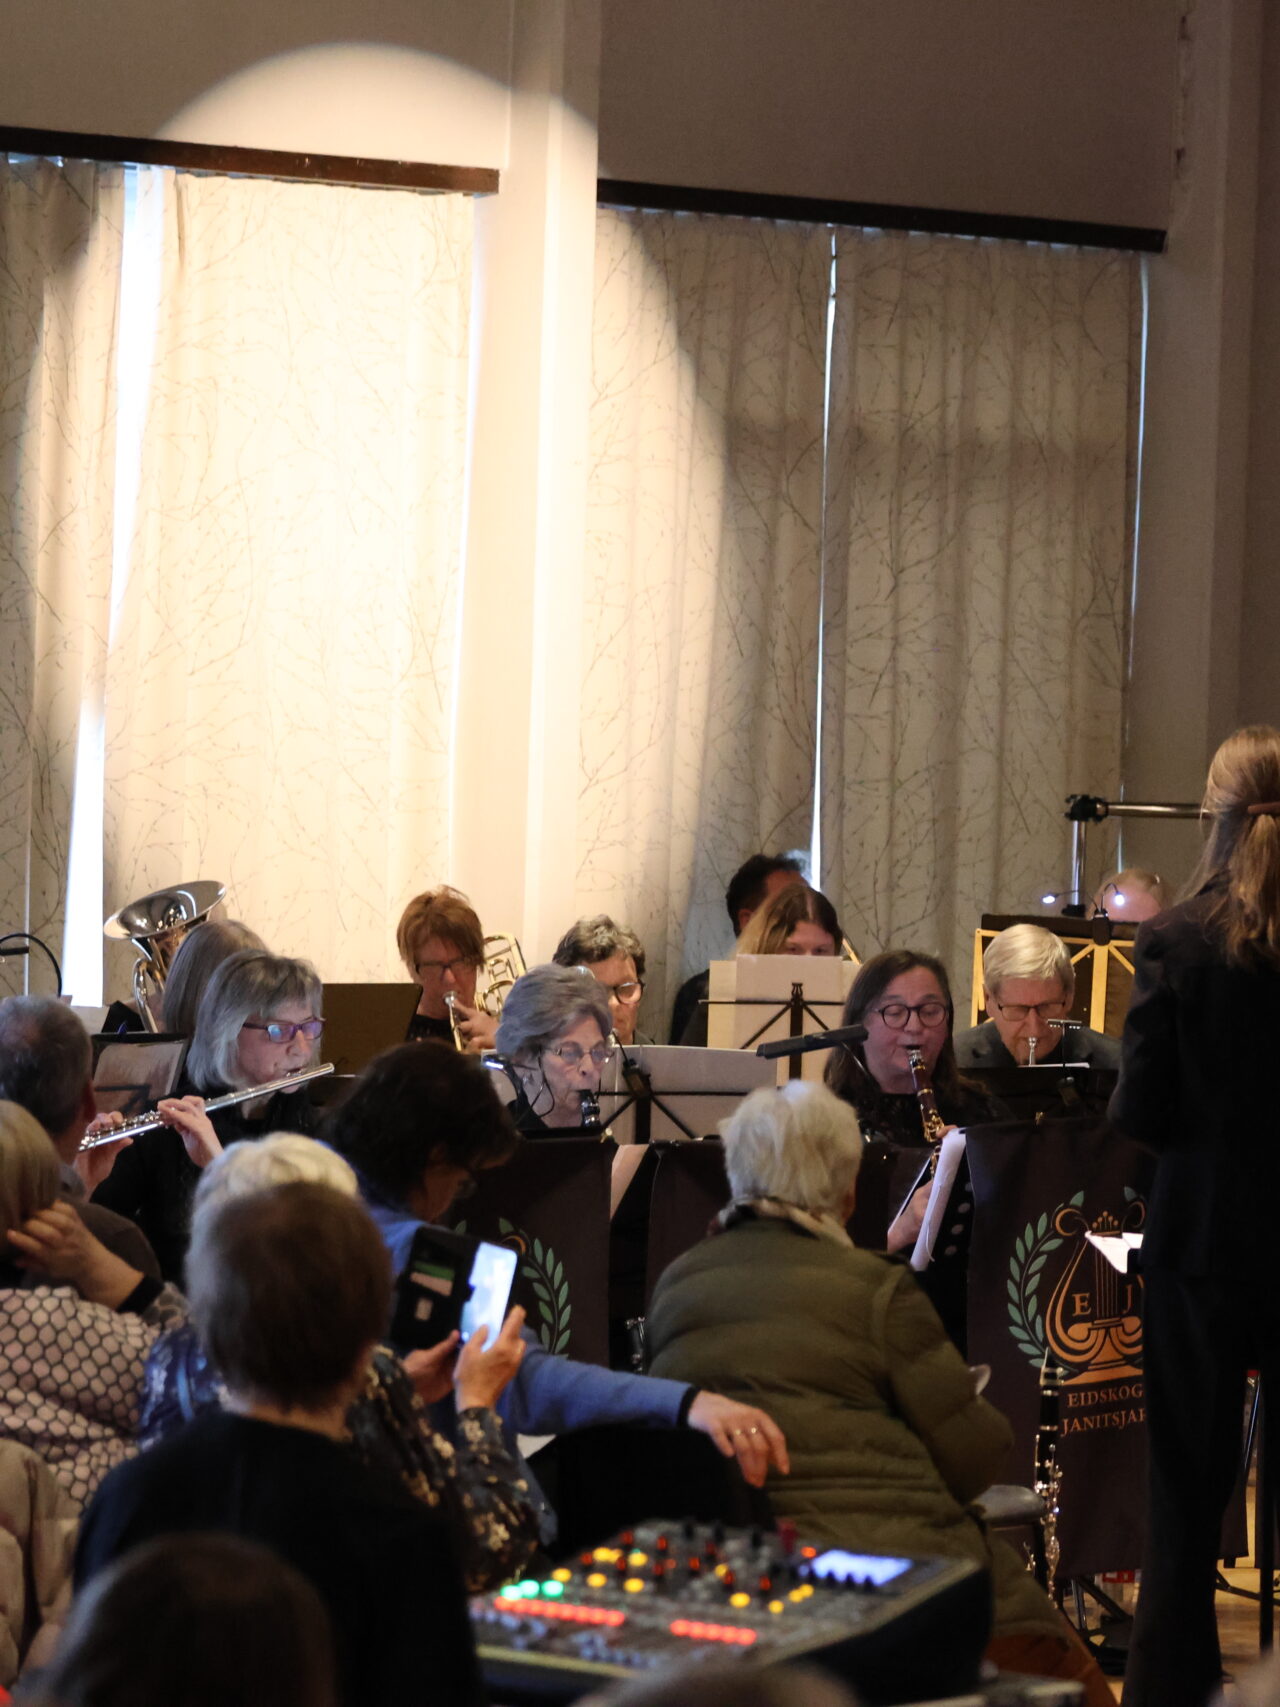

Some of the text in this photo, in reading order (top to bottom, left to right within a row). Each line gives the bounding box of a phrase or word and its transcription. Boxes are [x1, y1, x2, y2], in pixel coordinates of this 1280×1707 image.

[1071, 1284, 1134, 1317] E J
[1067, 1383, 1144, 1408] EIDSKOG
